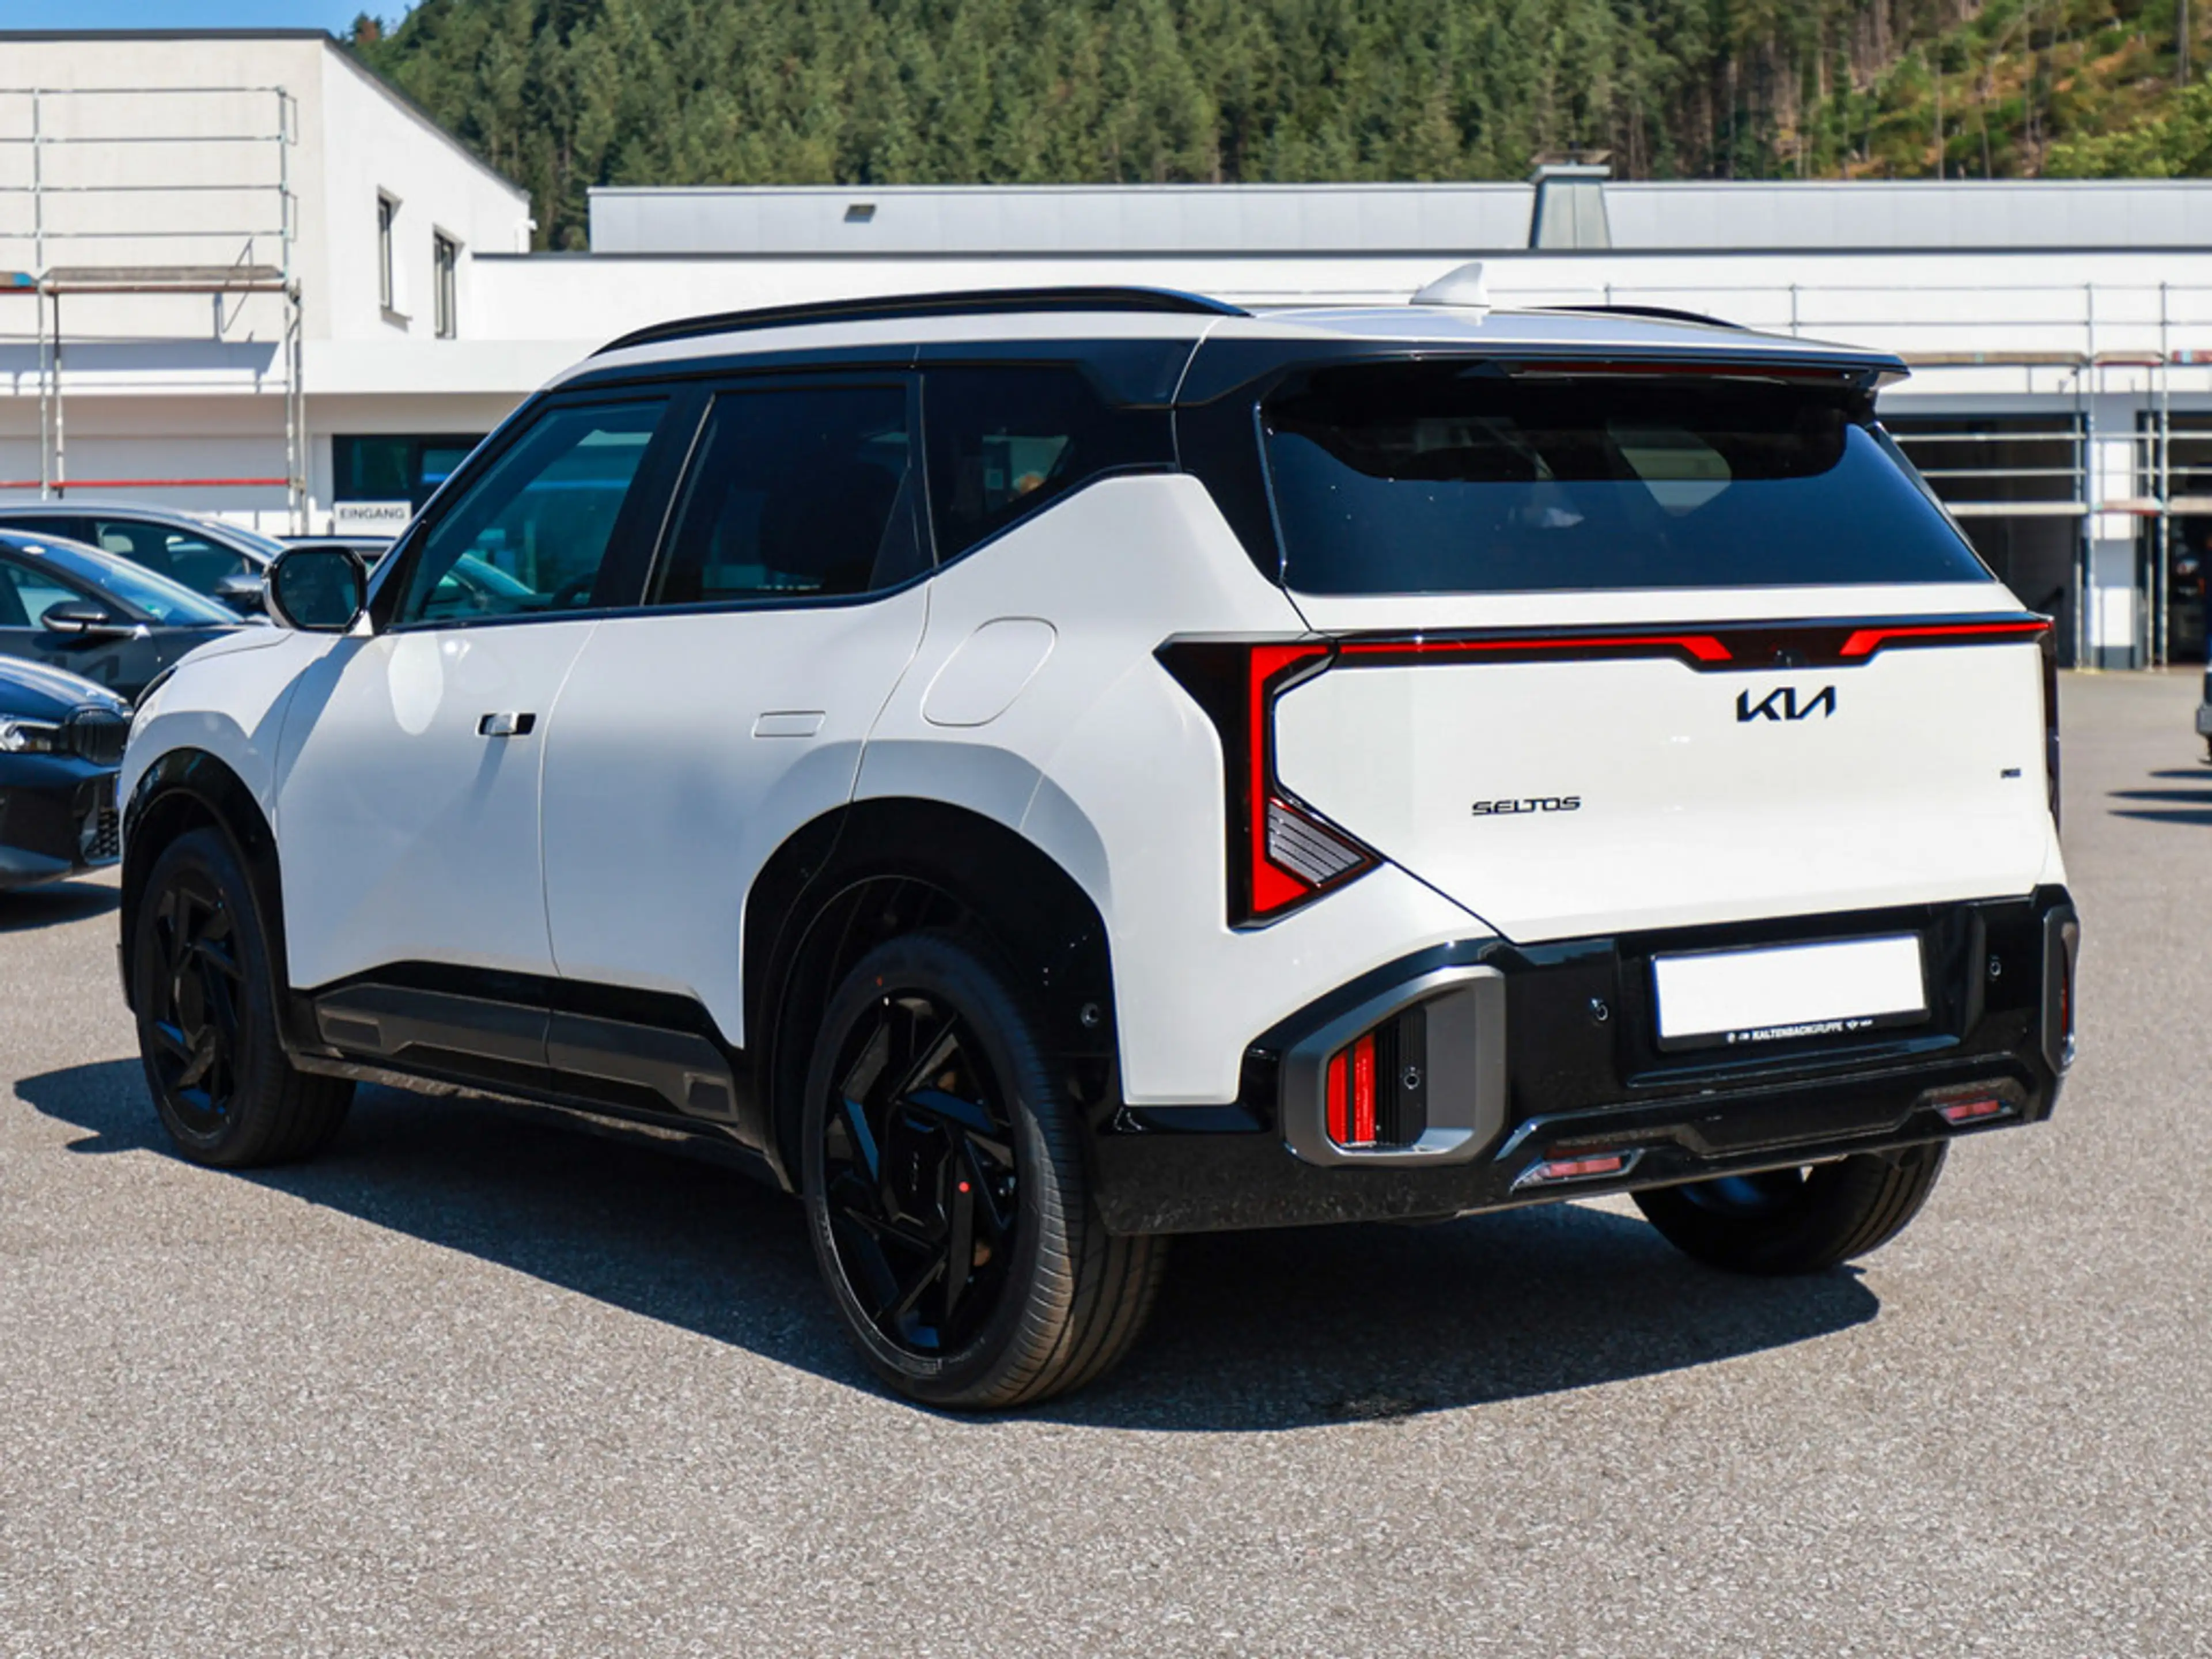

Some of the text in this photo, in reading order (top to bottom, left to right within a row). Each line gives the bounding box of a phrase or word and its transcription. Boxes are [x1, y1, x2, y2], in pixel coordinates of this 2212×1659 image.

[340, 507, 406, 519] EINGANG
[1736, 685, 1836, 722] KIA
[1472, 797, 1581, 816] SELTOS
